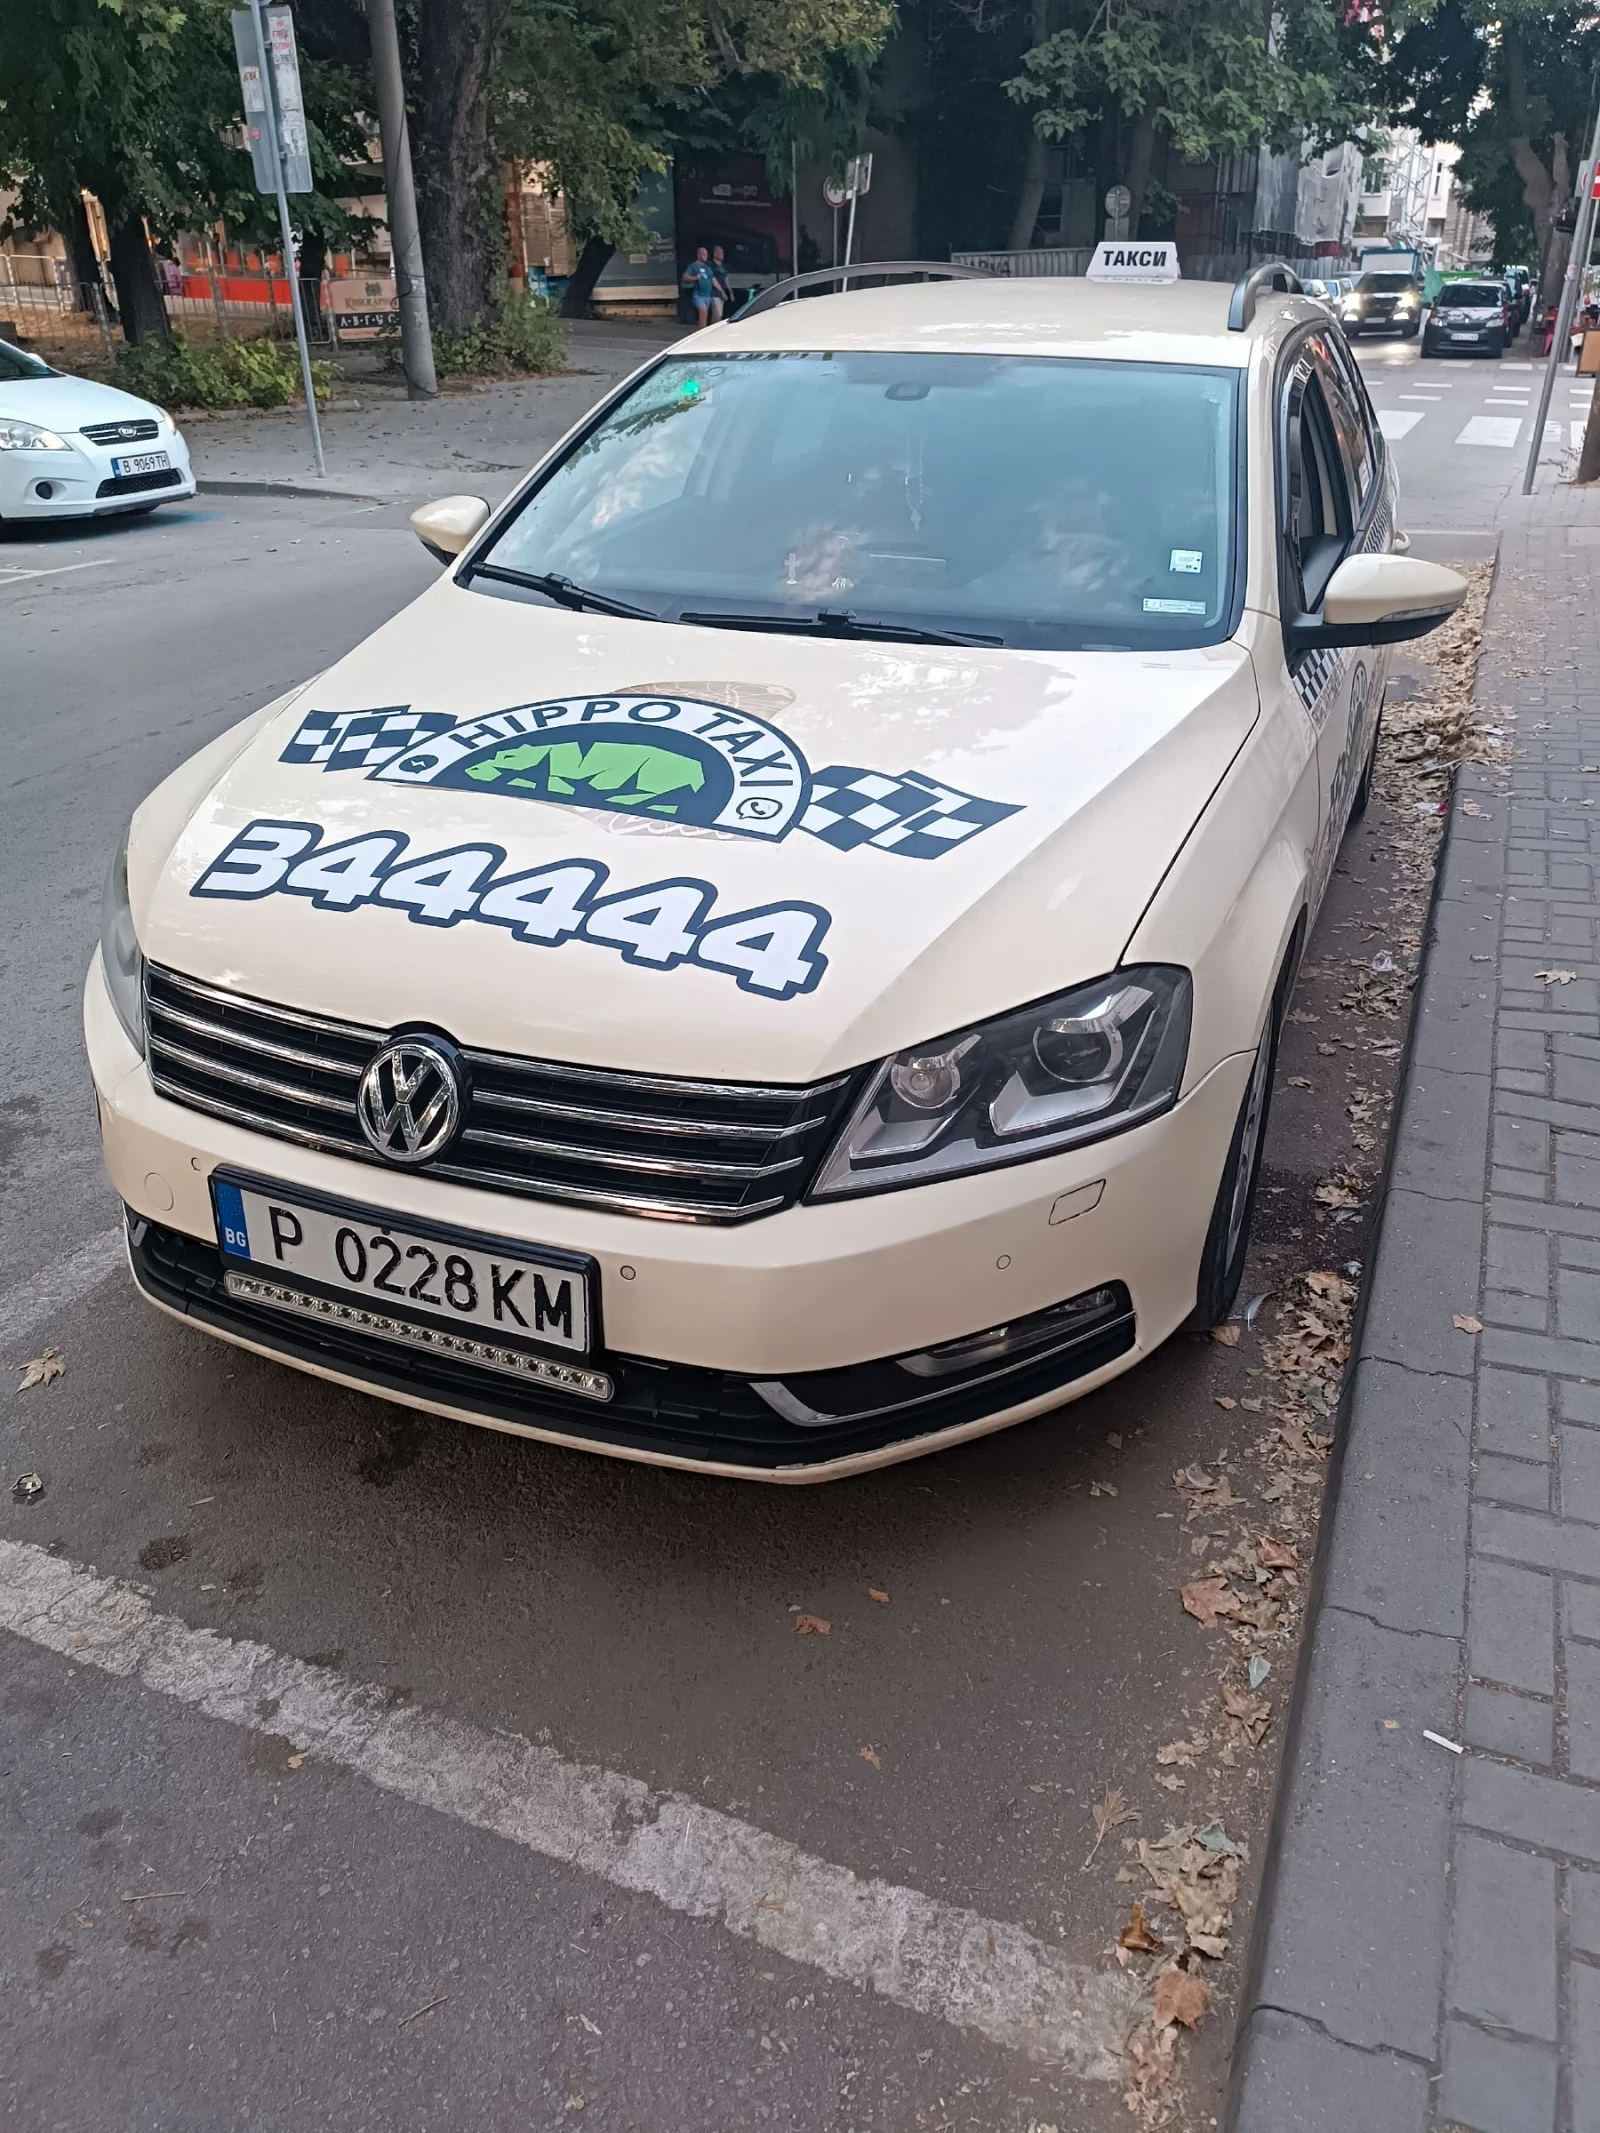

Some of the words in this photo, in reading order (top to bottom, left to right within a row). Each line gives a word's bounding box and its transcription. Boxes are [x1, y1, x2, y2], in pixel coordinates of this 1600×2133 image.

[1103, 250, 1167, 267] ТАКСИ
[448, 700, 682, 750] HIPPO
[693, 711, 794, 788] TAXI
[189, 818, 833, 1001] 344444
[224, 1226, 247, 1248] BG
[268, 1205, 303, 1261] P
